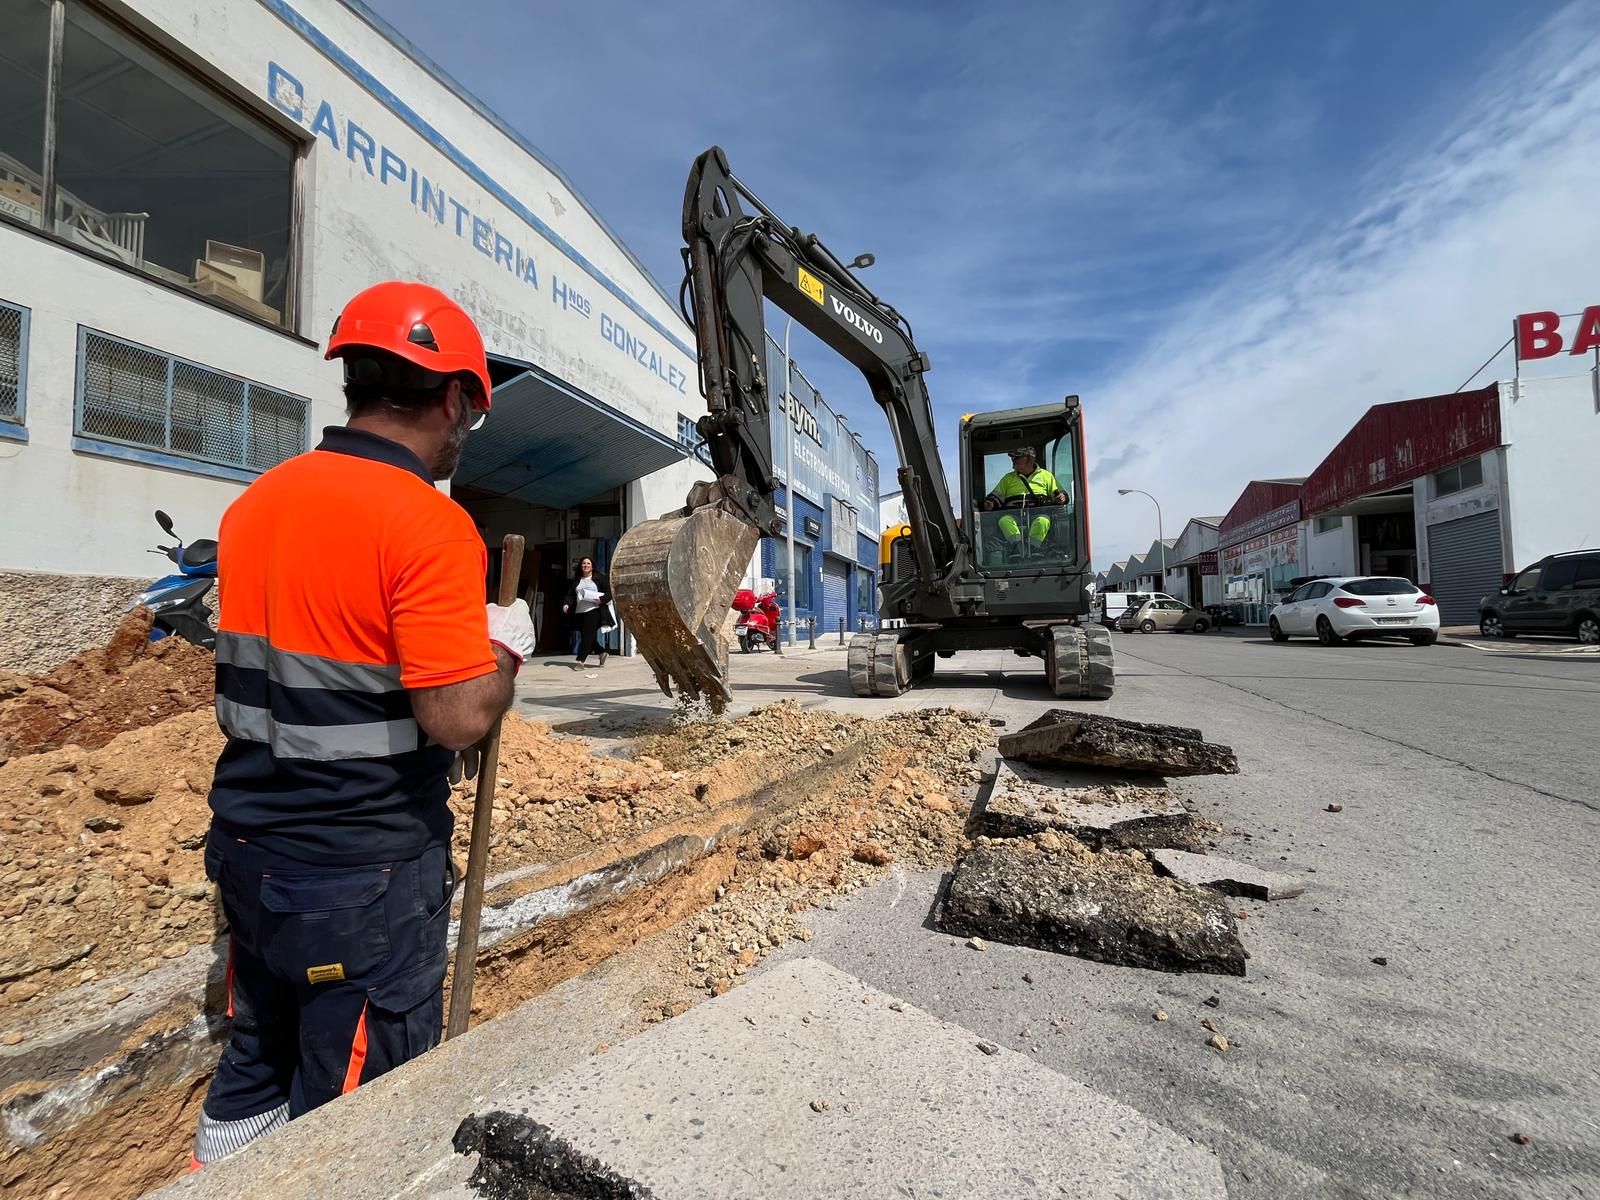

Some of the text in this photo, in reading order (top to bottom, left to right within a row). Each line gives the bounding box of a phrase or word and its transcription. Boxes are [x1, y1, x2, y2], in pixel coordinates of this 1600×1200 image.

[268, 61, 539, 290] CARPINTERIA
[600, 312, 688, 395] GONZALEZ
[829, 294, 883, 344] VOLVO
[794, 438, 850, 498] ELECTRODOMESTCOS
